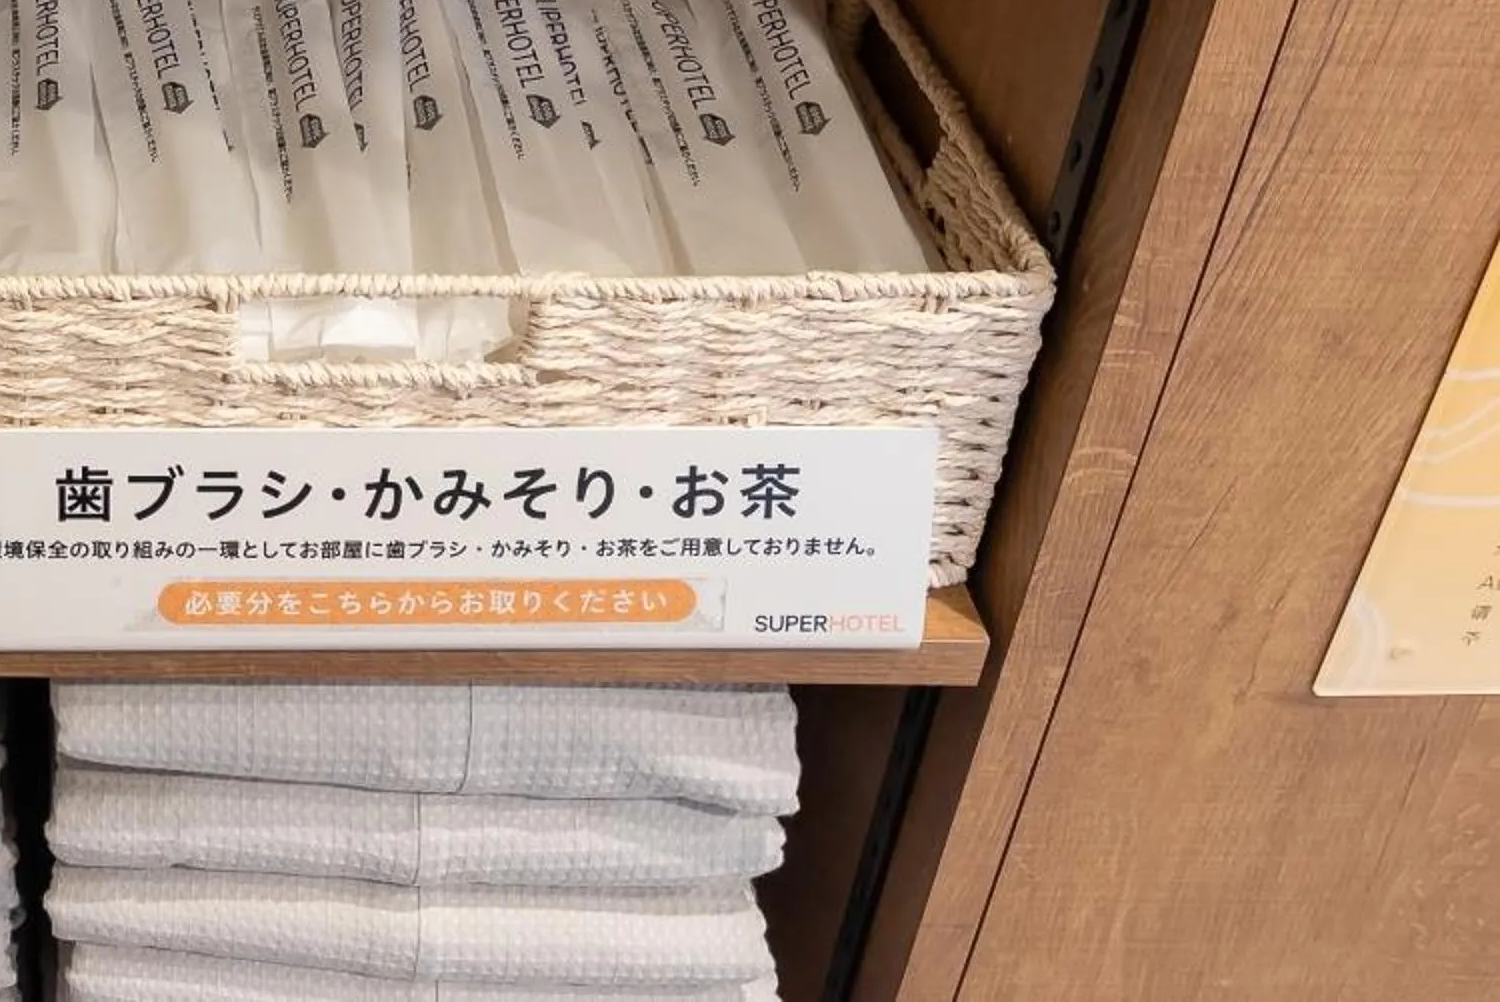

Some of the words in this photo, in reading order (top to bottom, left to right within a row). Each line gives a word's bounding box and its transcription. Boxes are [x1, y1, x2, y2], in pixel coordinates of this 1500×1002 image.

[55, 463, 800, 522] 歯ブラシ・かみそり・お茶
[185, 588, 667, 616] 必要分をこちらからお取りください
